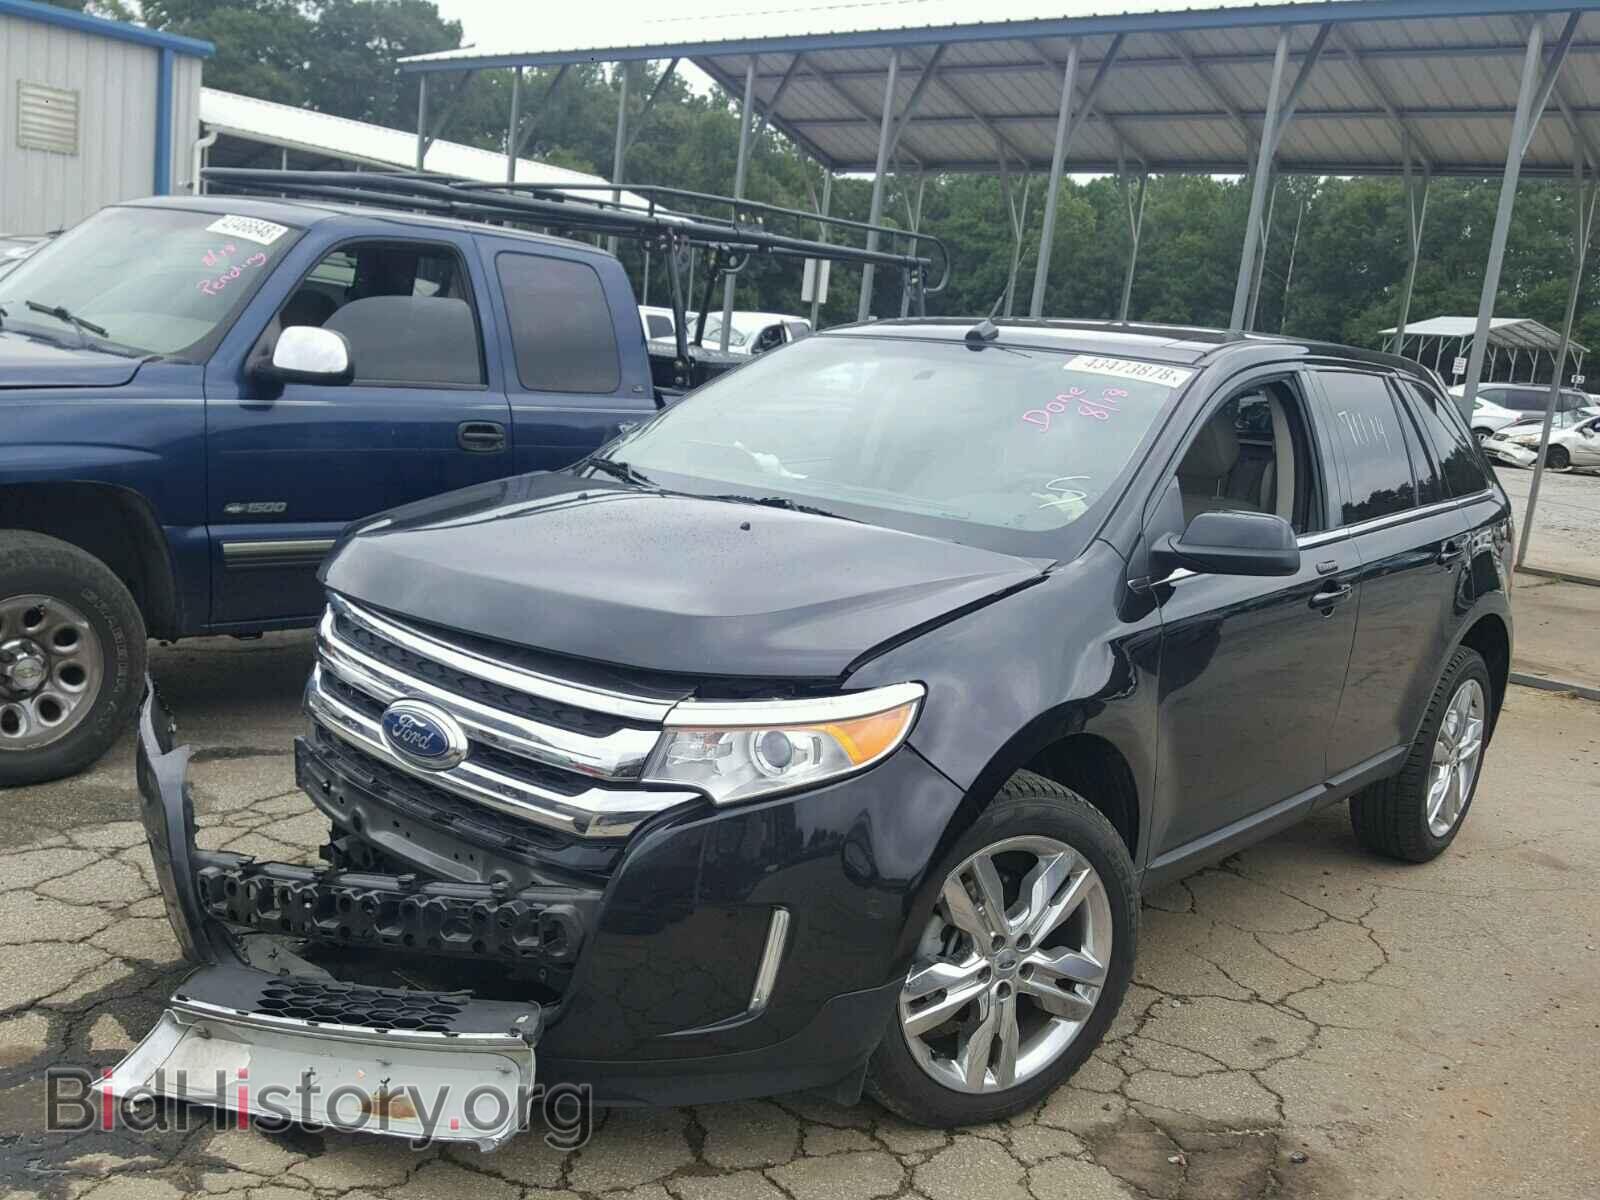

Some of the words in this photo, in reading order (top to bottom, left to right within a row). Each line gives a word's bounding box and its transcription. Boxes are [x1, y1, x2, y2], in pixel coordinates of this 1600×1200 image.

[1022, 386, 1087, 432] Done
[1078, 388, 1128, 421] 8/18
[248, 501, 288, 513] 1500
[392, 714, 435, 750] Ford
